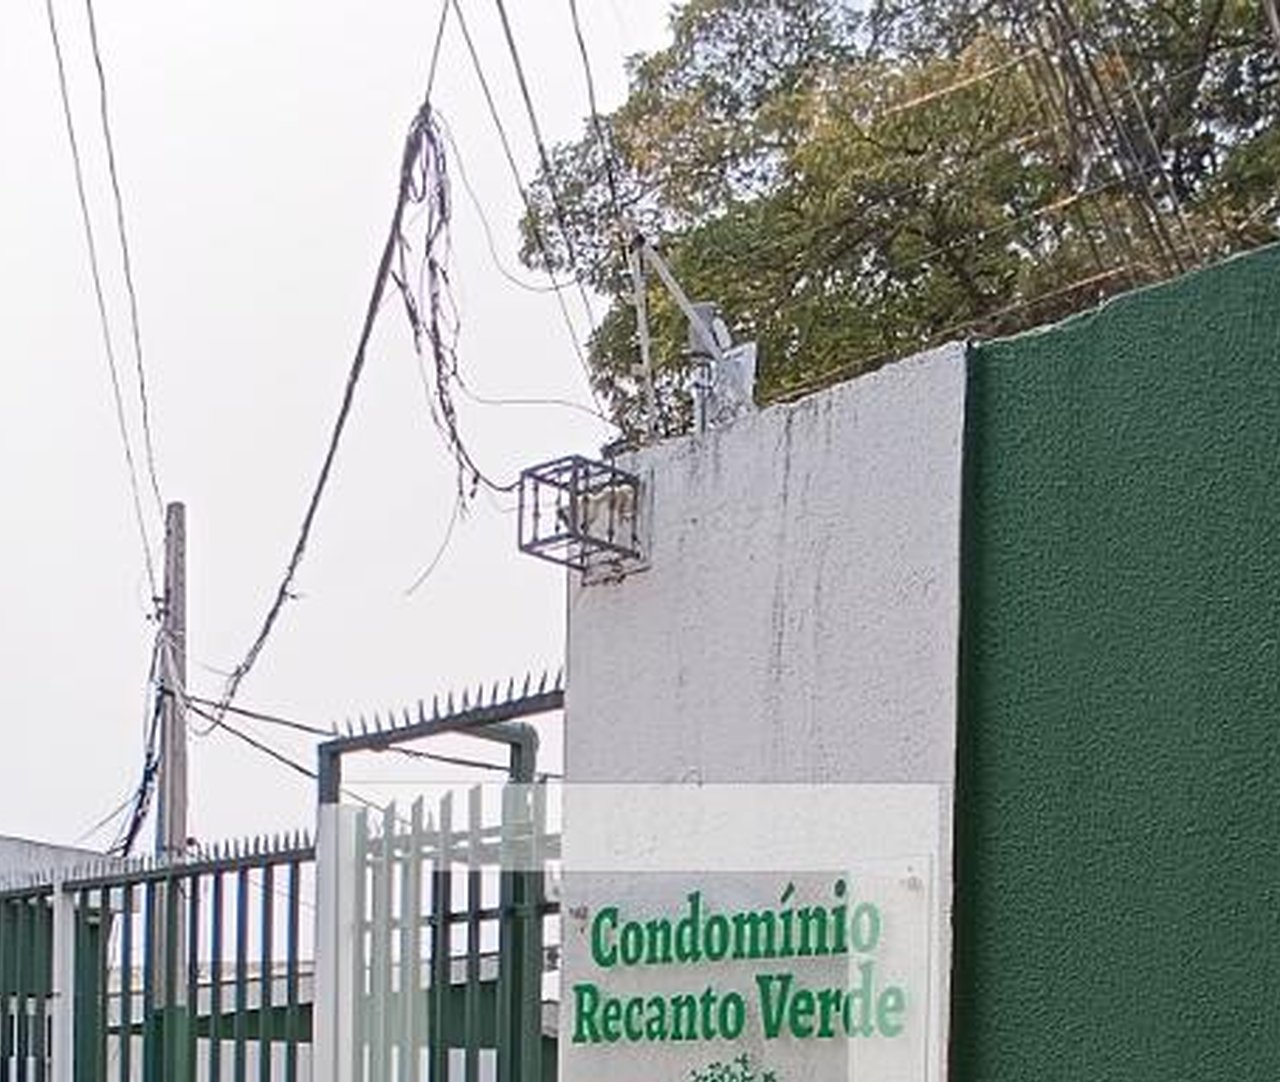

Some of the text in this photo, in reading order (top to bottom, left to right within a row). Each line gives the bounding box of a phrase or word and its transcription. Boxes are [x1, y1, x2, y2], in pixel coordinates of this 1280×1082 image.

[591, 879, 881, 967] Condomínio
[572, 961, 906, 1043] Recanto Verde
